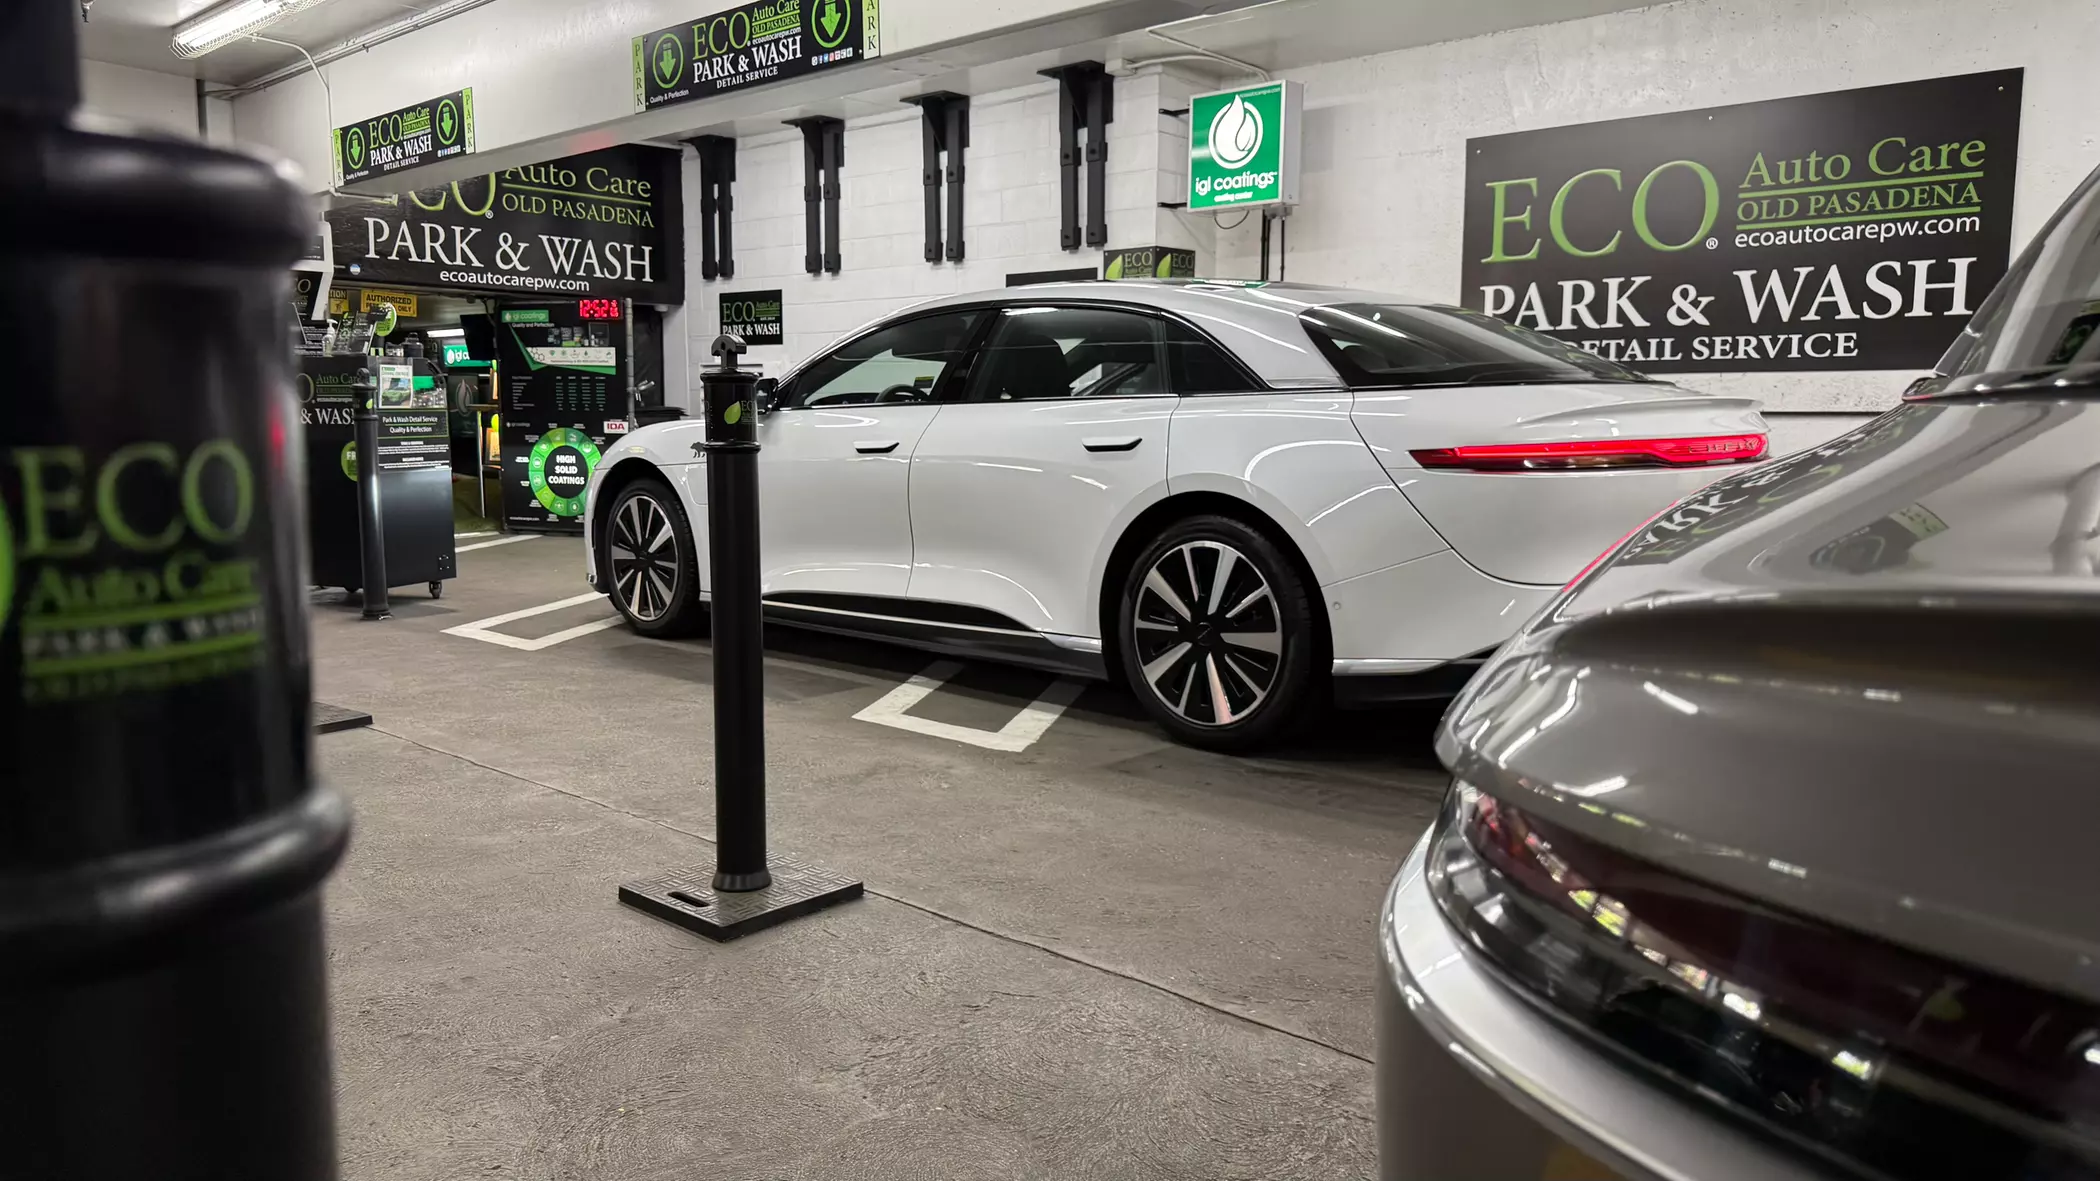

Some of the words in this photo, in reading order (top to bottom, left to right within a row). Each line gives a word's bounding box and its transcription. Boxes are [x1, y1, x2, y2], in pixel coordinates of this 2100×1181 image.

[752, 6, 775, 22] Auto
[777, 0, 800, 14] Care
[752, 24, 766, 34] OLD
[767, 14, 800, 31] PASADENA
[693, 53, 735, 84] PARK
[738, 54, 749, 73] &
[751, 36, 802, 69] WASH
[634, 44, 644, 107] PARK
[716, 74, 744, 90] DETAIL
[745, 66, 778, 83] SERVICE
[649, 95, 664, 104] Quality
[370, 144, 395, 167] PARK
[395, 147, 402, 160] &
[403, 135, 432, 157] WASH
[1740, 151, 1851, 188] Auto
[1868, 136, 1987, 176] Care
[383, 161, 400, 171] DETAIL
[400, 156, 419, 167] SERVICE
[501, 165, 577, 188] Auto
[586, 166, 652, 198] Care
[1195, 175, 1211, 196] igl
[502, 193, 546, 215] OLD
[552, 198, 655, 228] PASADENA
[1736, 195, 1799, 222] OLD
[1806, 181, 1982, 217] PASADENA
[1735, 214, 1981, 248] ecoautocarepw.com
[364, 217, 484, 268] PARK
[495, 231, 531, 272] &
[538, 233, 654, 283] WASH
[1124, 251, 1152, 267] ECO
[440, 268, 590, 293] ecoautocarepw.com
[366, 294, 412, 305] AUTHORIZED
[1480, 275, 1652, 331] PARK
[1665, 283, 1716, 327] &
[1733, 256, 1977, 323] WASH
[722, 325, 745, 336] PARK
[746, 324, 753, 336] &
[754, 323, 780, 335] WASH
[1565, 338, 1682, 361] ETAIL
[1691, 332, 1859, 360] SERVICE
[316, 374, 339, 384] Auto
[300, 409, 312, 425] &
[555, 466, 578, 474] SOLID
[556, 455, 576, 463] HIGH
[548, 475, 585, 485] COATINGS
[12, 438, 253, 558] ECO
